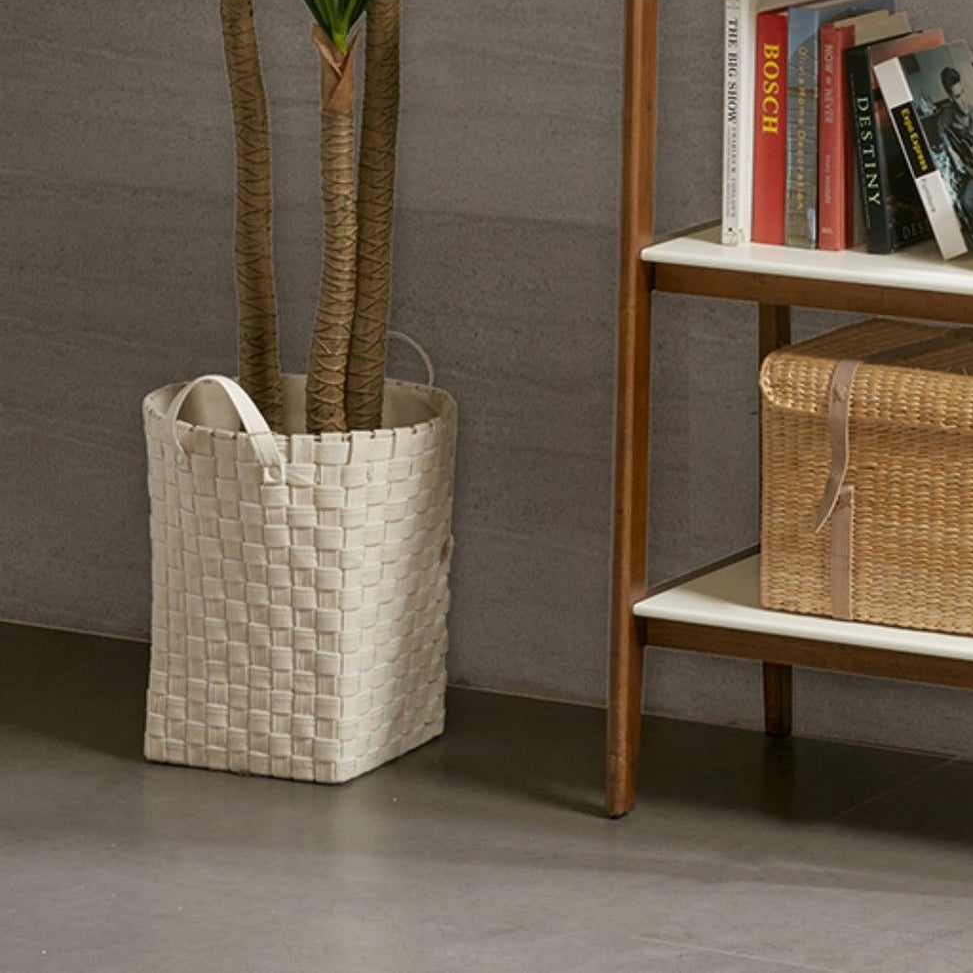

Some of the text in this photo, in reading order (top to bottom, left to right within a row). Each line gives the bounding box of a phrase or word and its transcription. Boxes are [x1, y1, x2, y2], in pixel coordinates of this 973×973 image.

[727, 18, 738, 48] THE
[727, 52, 738, 78] BIG
[824, 44, 834, 73] NOW
[727, 81, 738, 125] SHOW
[762, 43, 780, 134] BOSCH
[797, 87, 806, 125] Home
[824, 89, 834, 124] NEVER
[856, 96, 881, 206] DESTINY
[900, 107, 928, 172] Expo Express
[796, 129, 806, 211] Decoration
